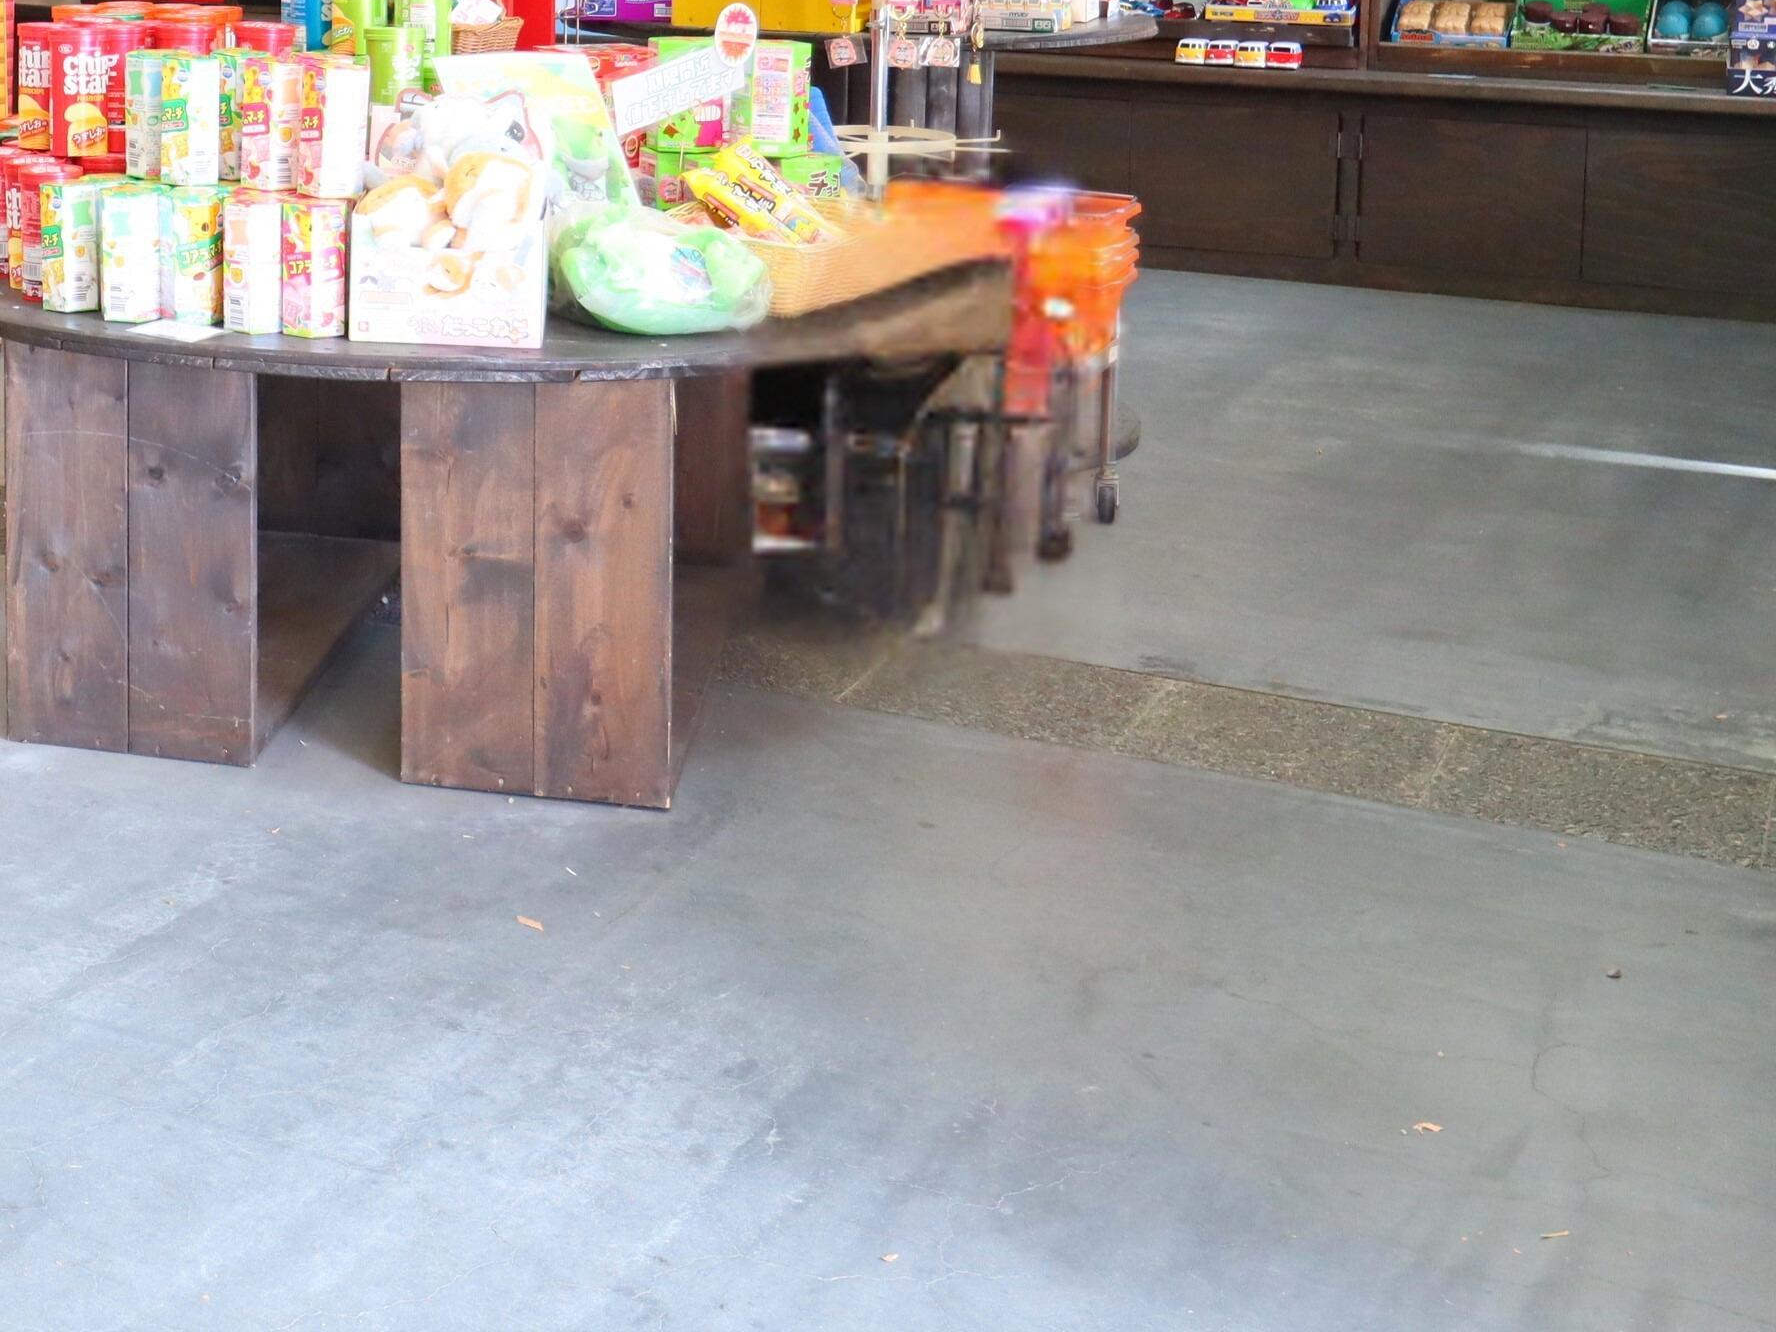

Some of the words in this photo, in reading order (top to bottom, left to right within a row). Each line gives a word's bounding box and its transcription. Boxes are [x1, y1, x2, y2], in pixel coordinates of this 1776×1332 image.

[624, 66, 736, 127] 値下げしてます
[645, 52, 711, 96] 期限間近
